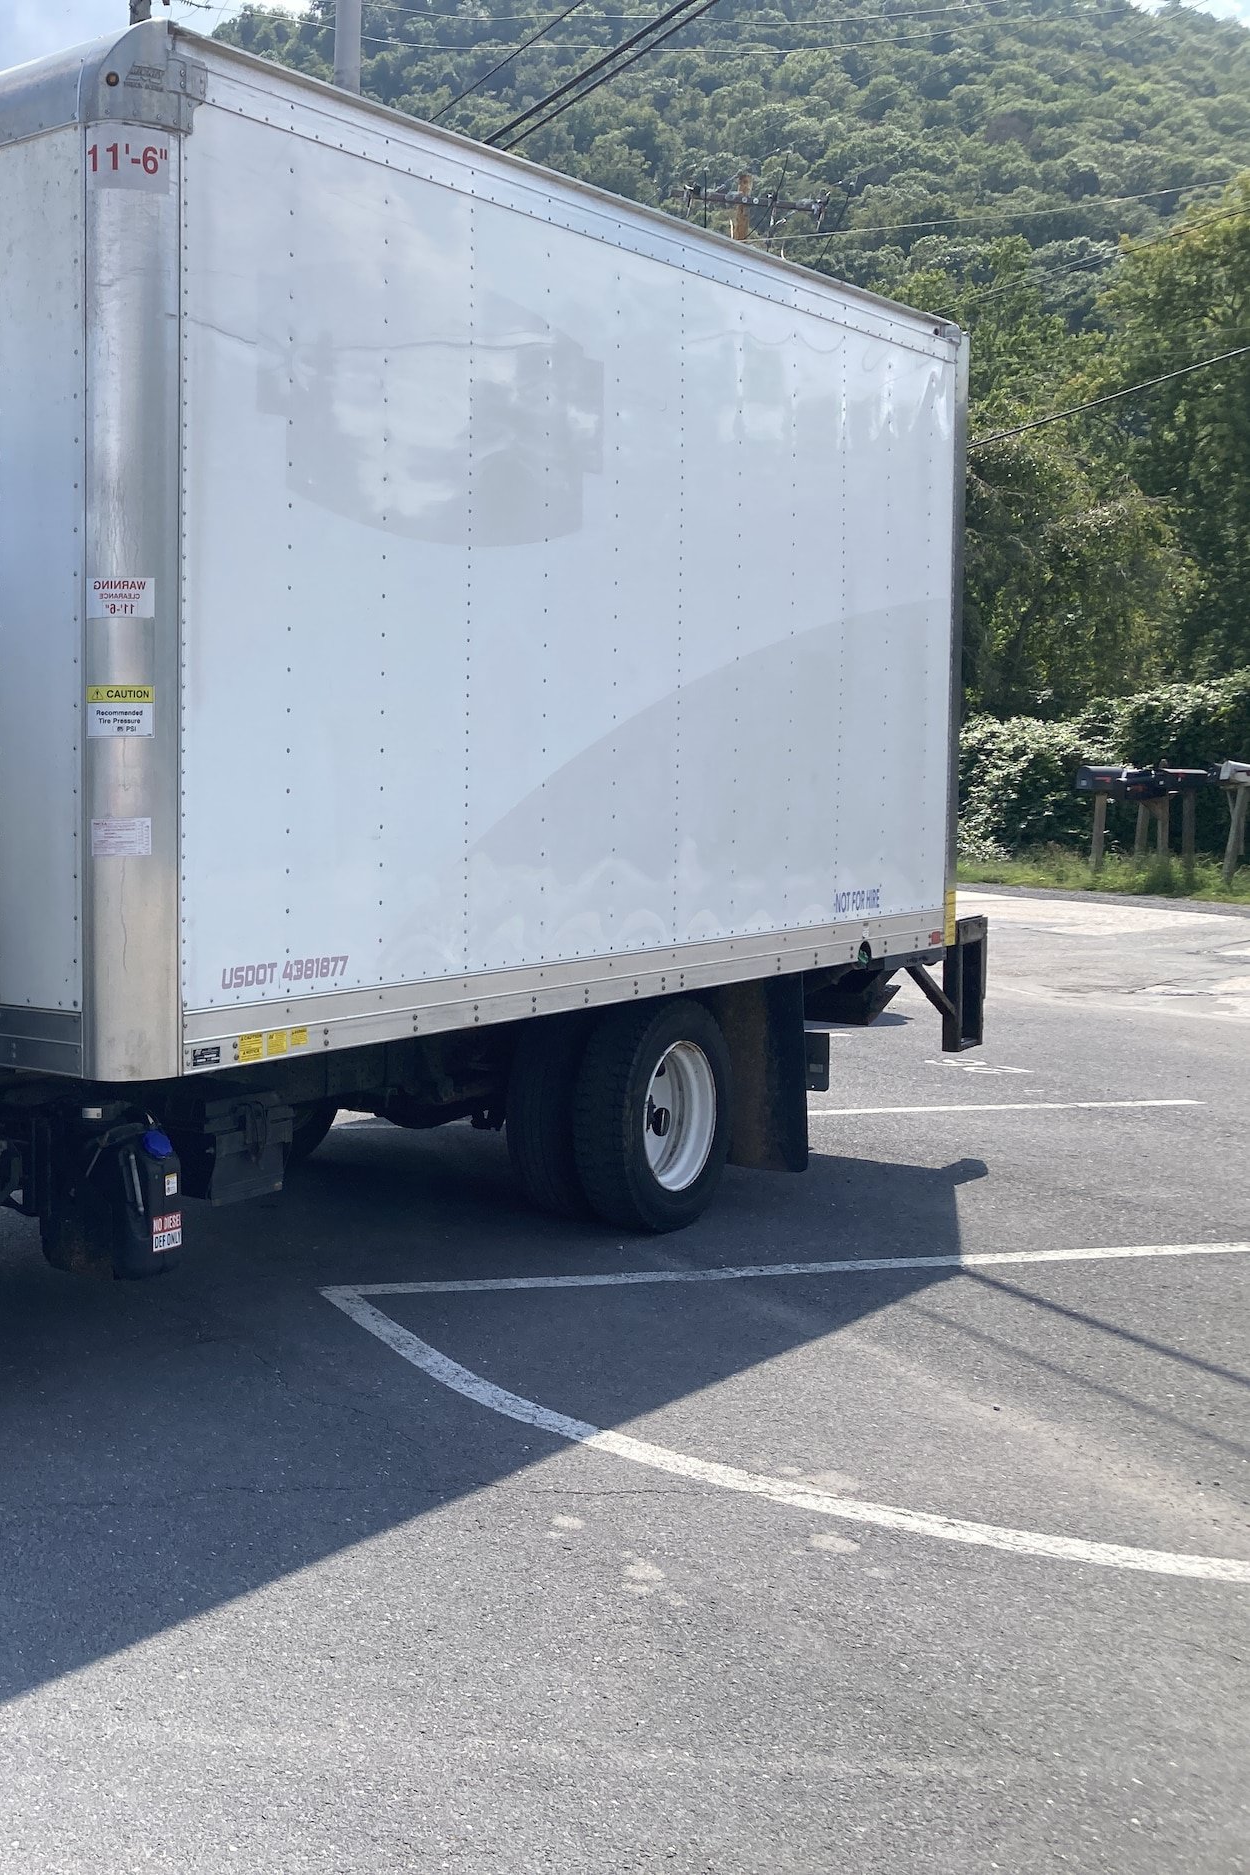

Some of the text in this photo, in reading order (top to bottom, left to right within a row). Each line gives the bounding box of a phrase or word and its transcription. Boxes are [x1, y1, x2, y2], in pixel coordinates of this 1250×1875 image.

[88, 143, 167, 174] 11'-6"
[106, 689, 150, 699] CAUTION
[835, 888, 880, 913] NOT FOR HIRE
[222, 955, 349, 990] USDOT 4381877
[153, 1218, 162, 1232] NO
[155, 1235, 166, 1248] DEF
